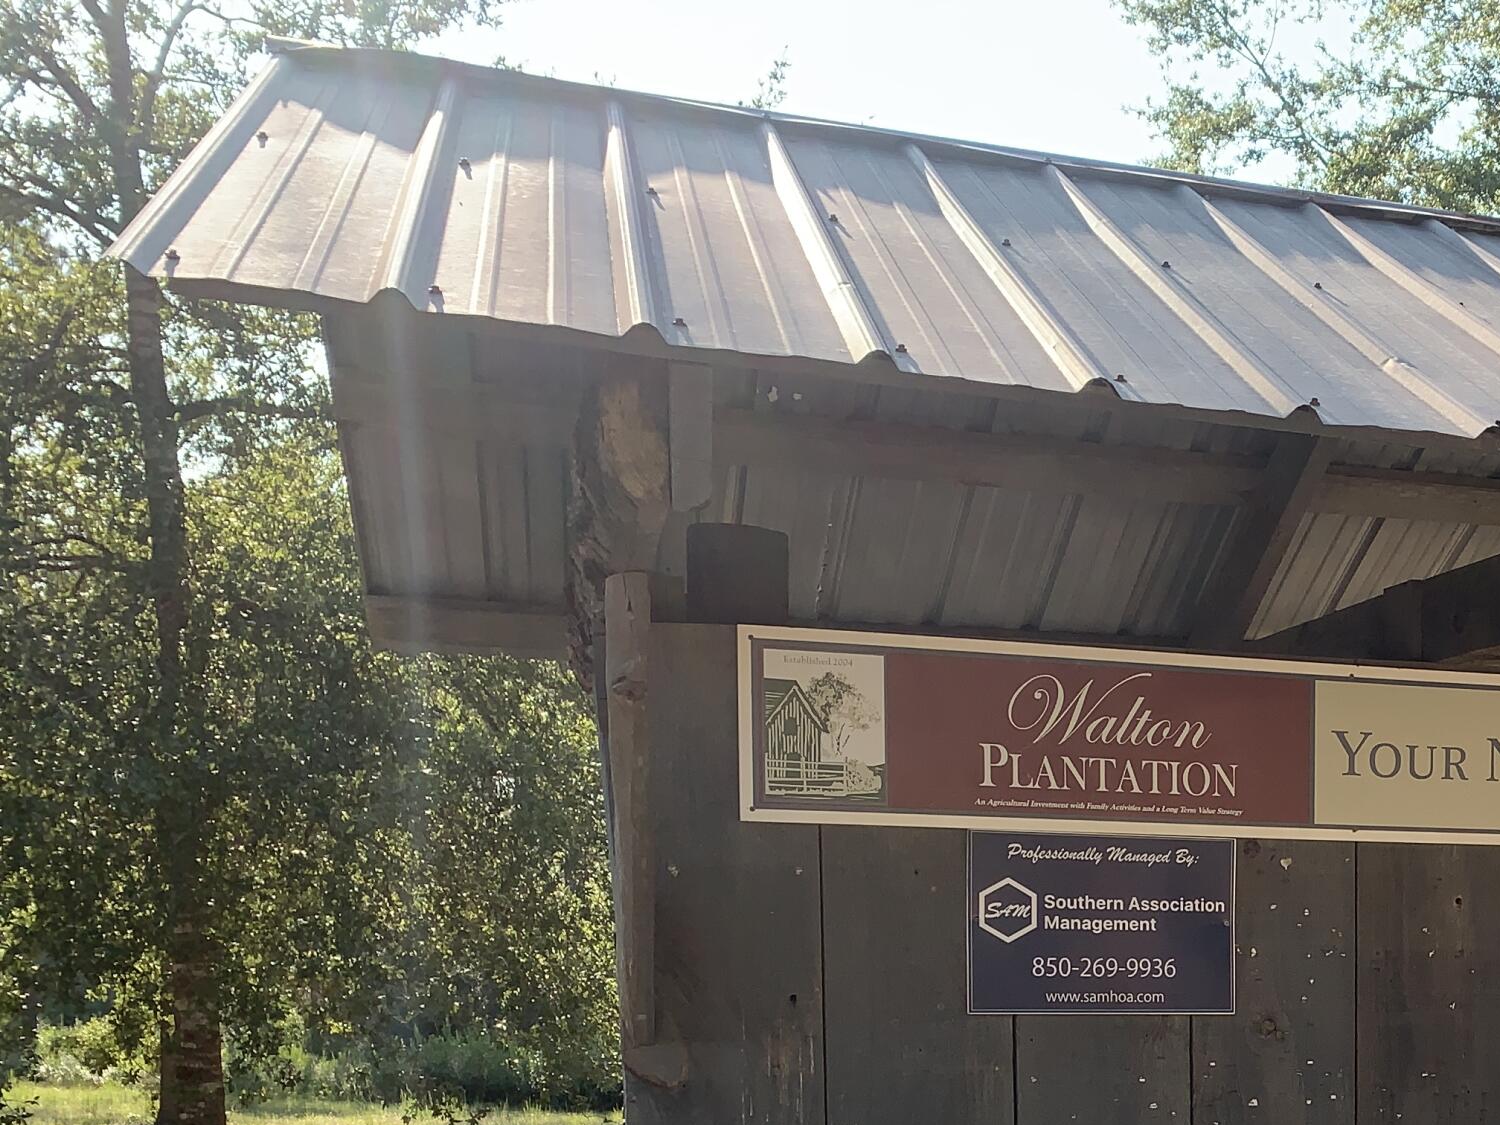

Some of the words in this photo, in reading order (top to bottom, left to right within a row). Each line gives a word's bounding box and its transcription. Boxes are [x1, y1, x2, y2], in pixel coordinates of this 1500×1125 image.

[1007, 672, 1212, 750] Walton
[1331, 729, 1469, 781] YOUR
[978, 742, 1239, 798] PLANTATION
[987, 799, 1029, 807] Agricultural
[1030, 800, 1068, 808] Investment
[1070, 801, 1085, 809] with
[1086, 802, 1109, 811] Family
[1110, 803, 1141, 811] Activities
[1142, 804, 1155, 812] and
[1161, 805, 1179, 814] Long
[1180, 806, 1197, 814] Term
[1198, 806, 1216, 815] Value
[1216, 807, 1244, 816] Strategy
[1007, 843, 1103, 865] Professionally
[1106, 846, 1171, 867] Managed
[1175, 848, 1199, 867] By:
[985, 901, 1031, 919] SAM
[1043, 894, 1124, 911] Southern
[1128, 896, 1225, 913] Association
[1043, 915, 1157, 934] Management
[1032, 956, 1177, 979] 850-269-9936
[1045, 990, 1165, 1004] www.samhoa.com
